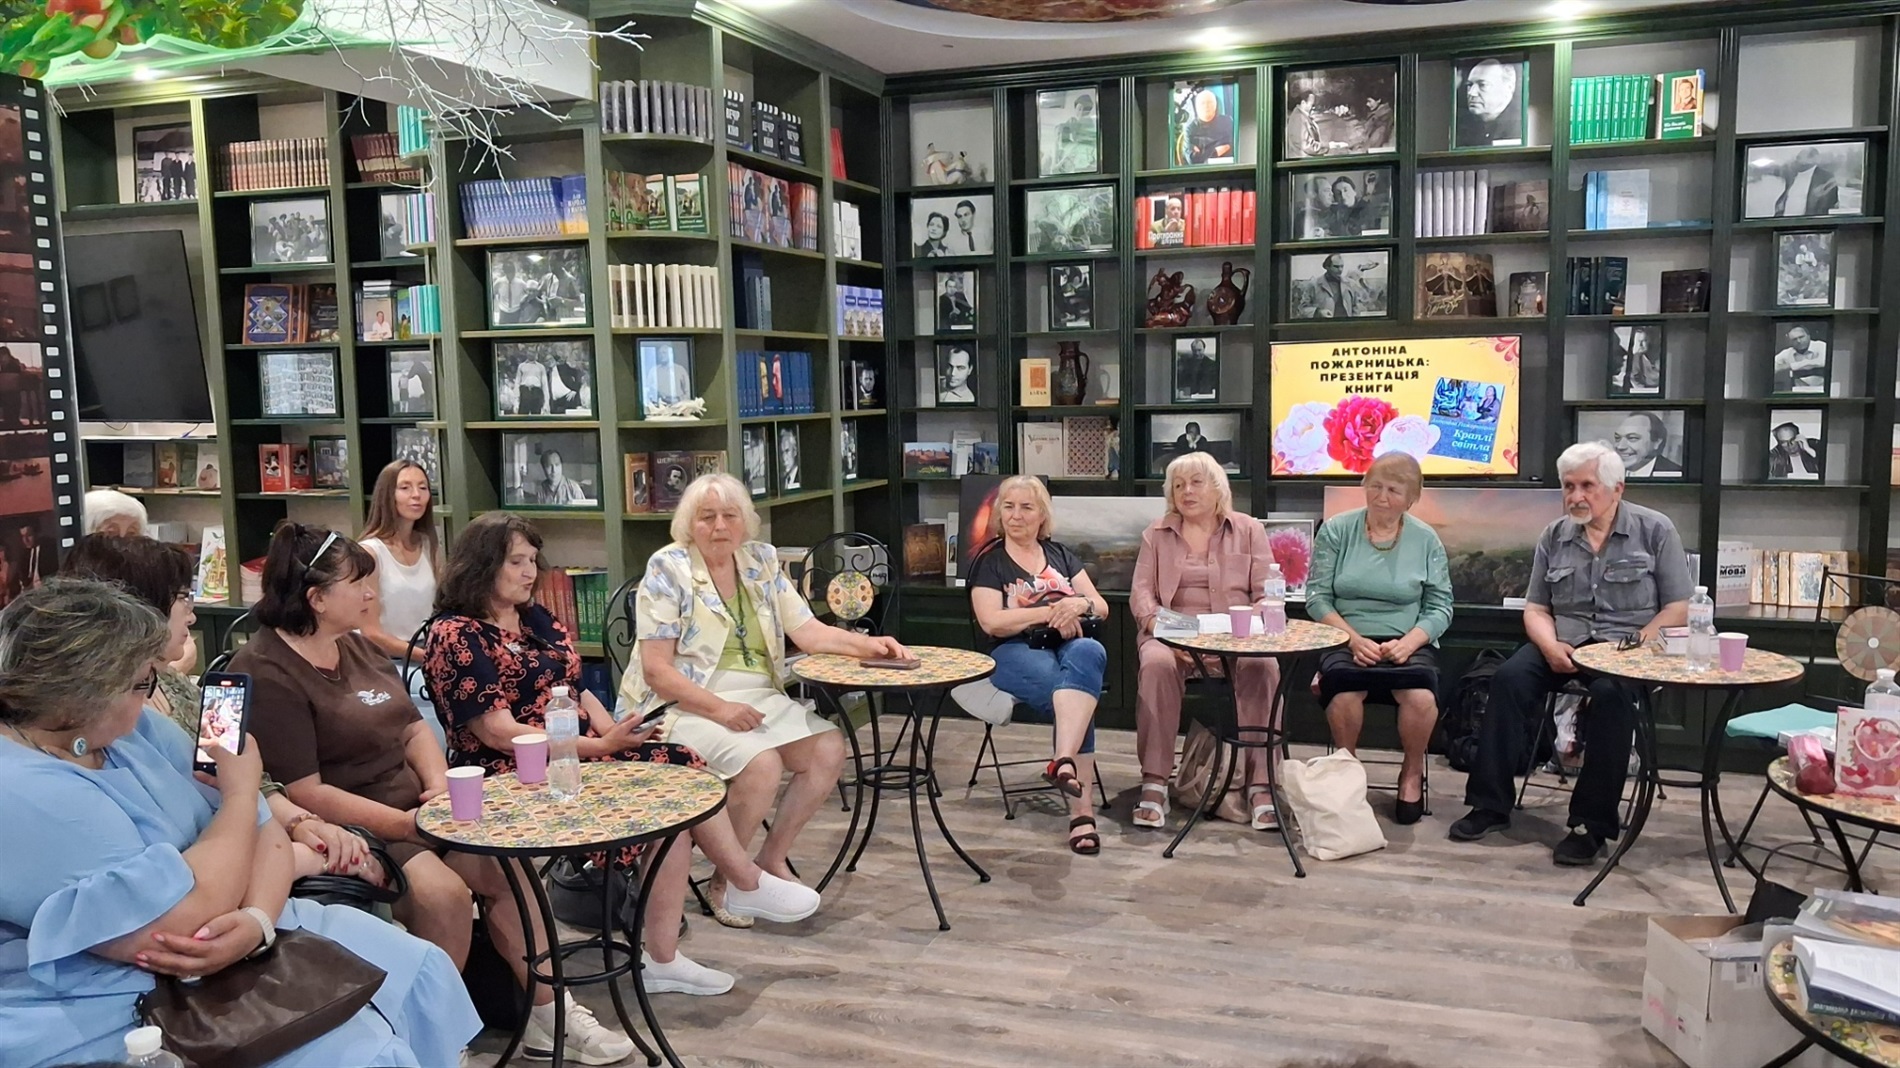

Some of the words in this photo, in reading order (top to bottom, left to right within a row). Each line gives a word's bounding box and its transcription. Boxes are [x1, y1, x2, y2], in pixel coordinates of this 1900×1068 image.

[1332, 345, 1407, 356] АНТОНІНА
[1310, 358, 1430, 370] ПОЖАРНИЦЬКА:
[1320, 371, 1419, 382] ПРЕЗЕНТАЦІЯ
[1345, 384, 1393, 393] КНИГИ
[1454, 429, 1493, 442] Краплі
[1451, 440, 1490, 452] світла
